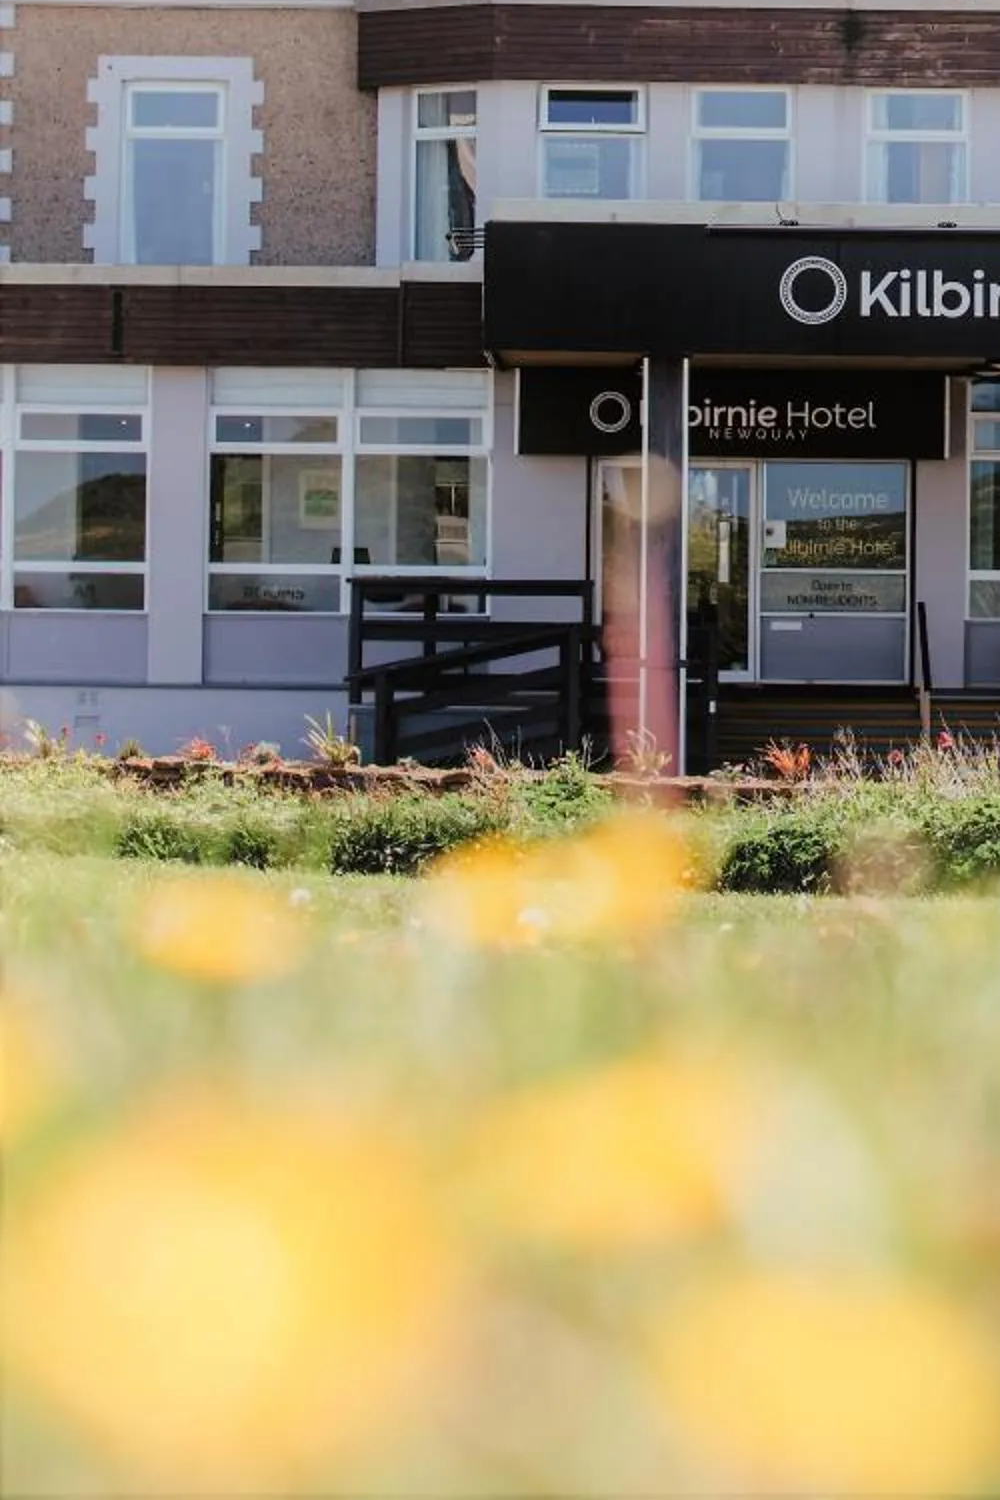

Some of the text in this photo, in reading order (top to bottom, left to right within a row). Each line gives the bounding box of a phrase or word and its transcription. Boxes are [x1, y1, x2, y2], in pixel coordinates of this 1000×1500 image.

[640, 398, 877, 429] birnie Hotel
[709, 427, 809, 440] NEWQUAY
[787, 487, 889, 511] Welcome
[850, 538, 897, 557] Hotel
